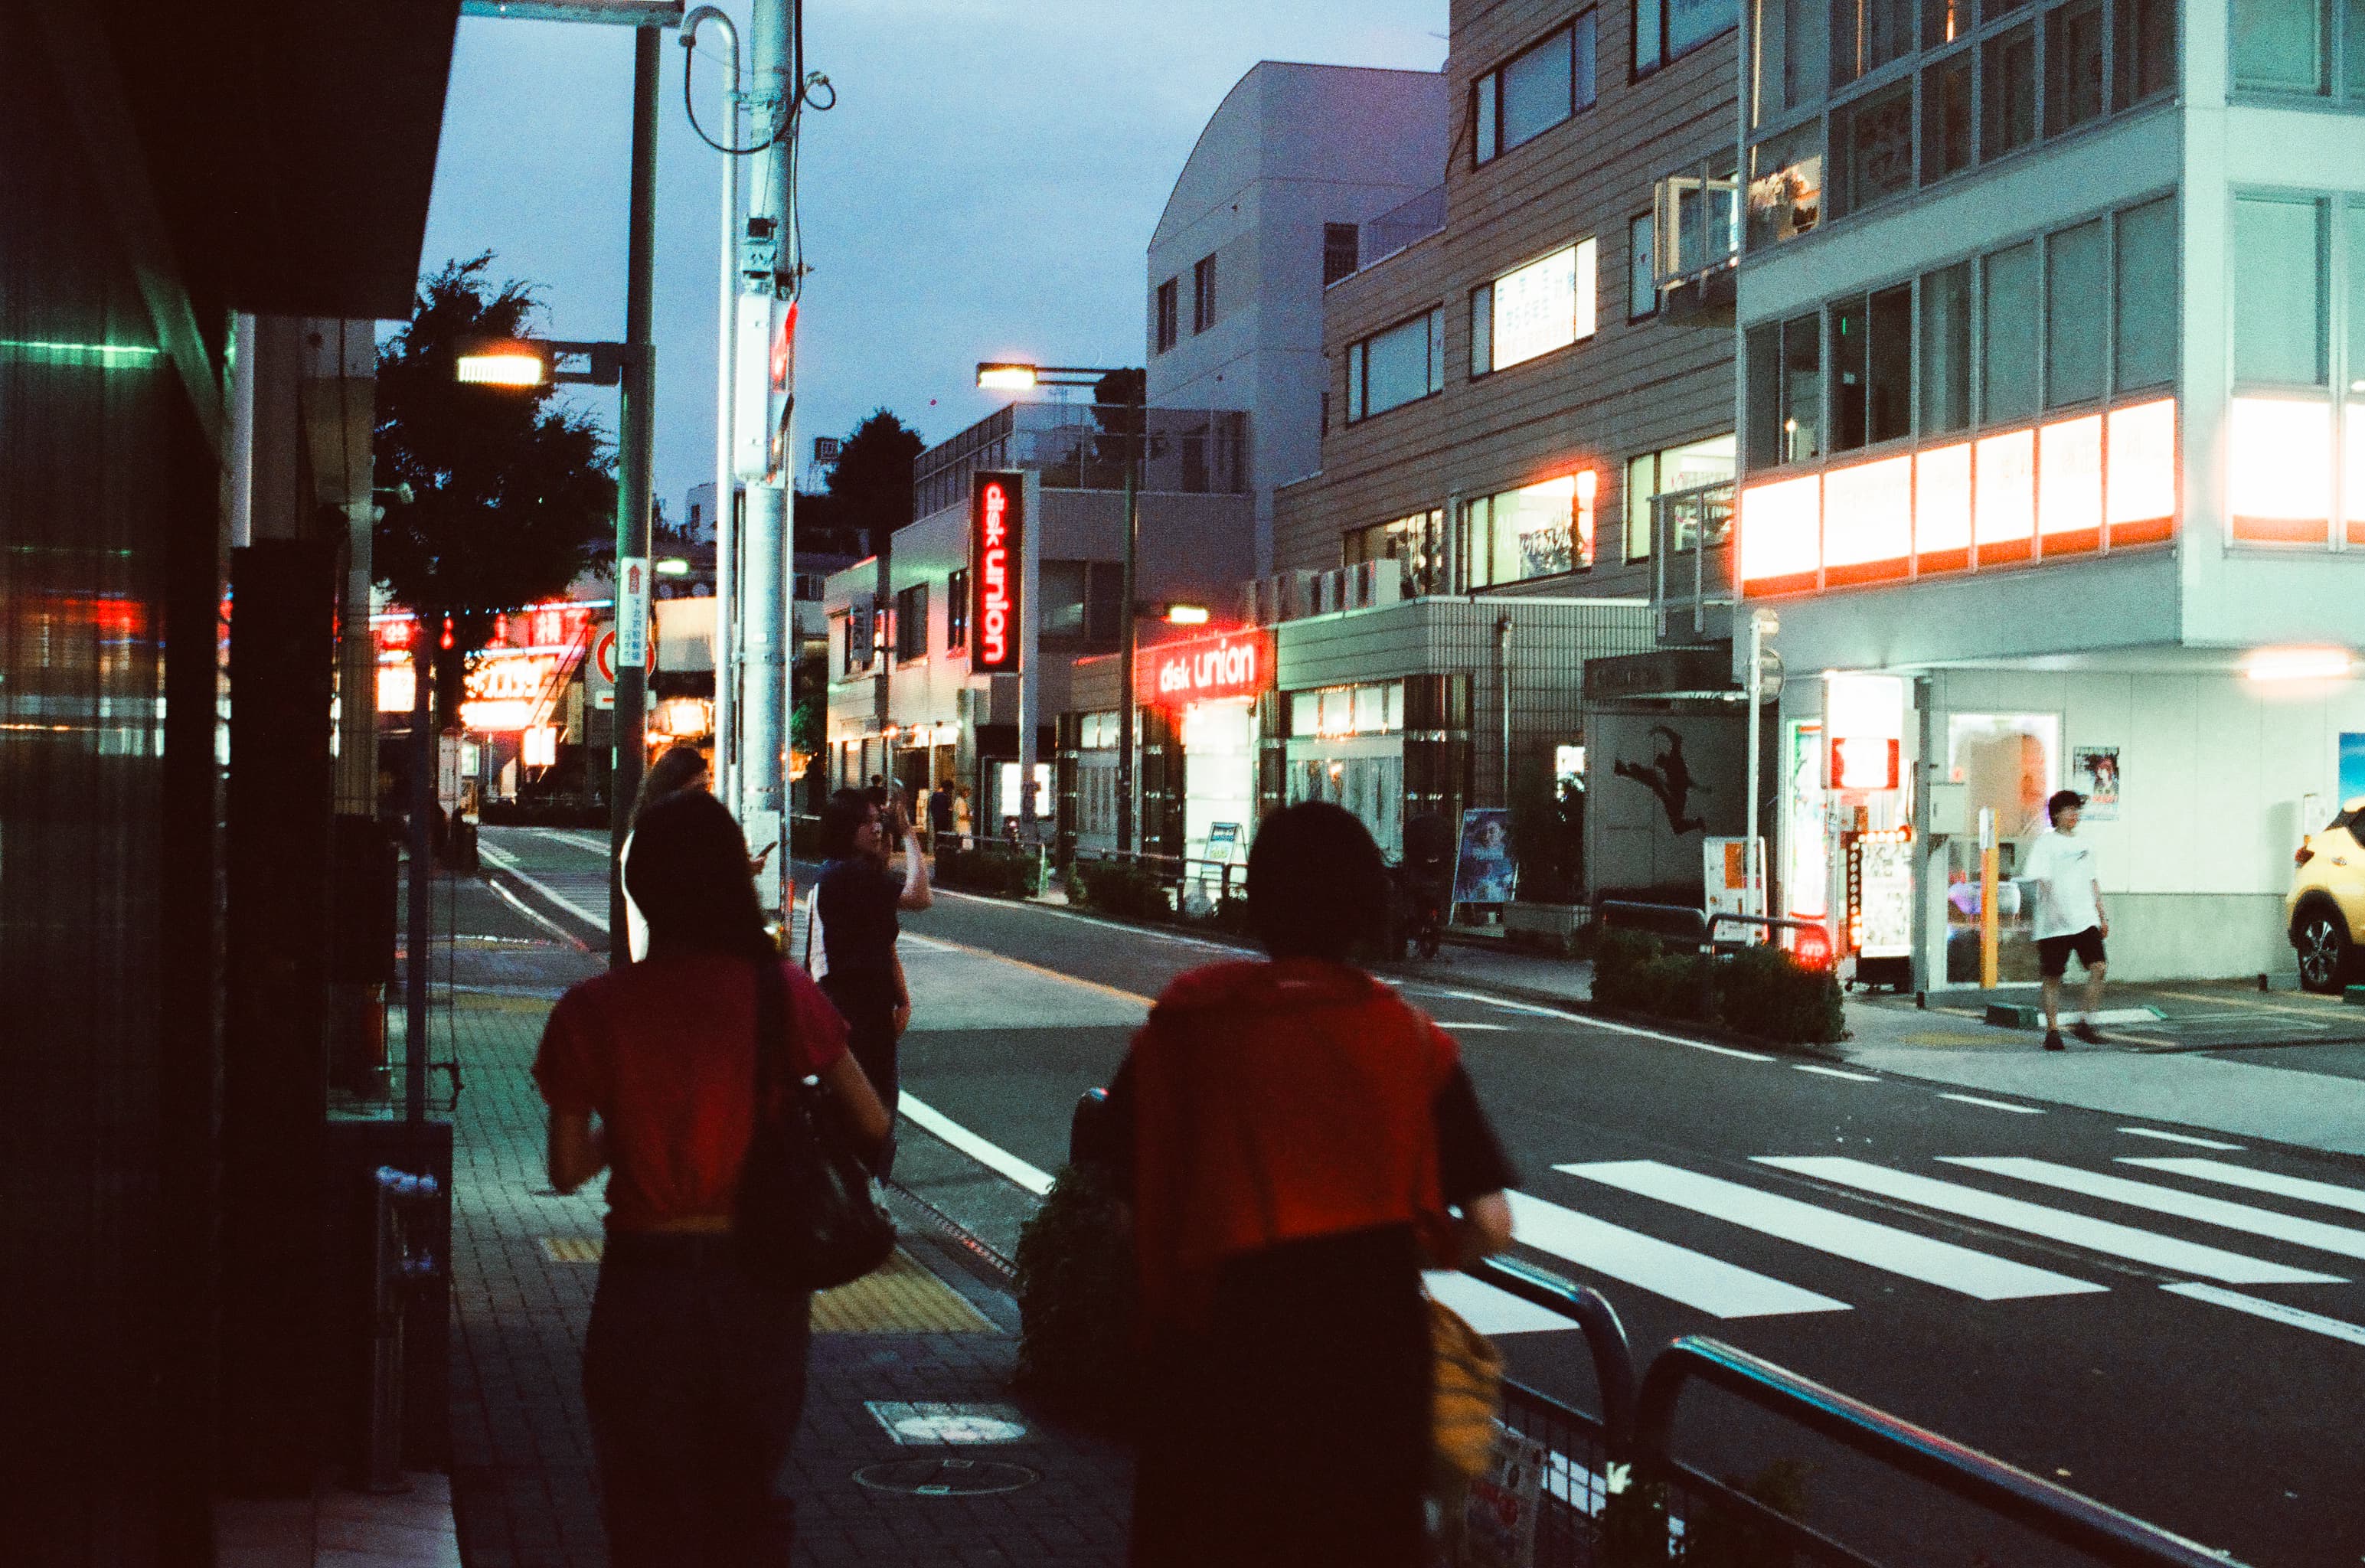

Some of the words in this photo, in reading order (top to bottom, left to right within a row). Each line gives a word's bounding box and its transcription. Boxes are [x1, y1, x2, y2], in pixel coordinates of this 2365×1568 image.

[986, 484, 1005, 547] disk
[985, 548, 1010, 662] union
[1160, 657, 1191, 693] disk
[1194, 637, 1255, 688] union
